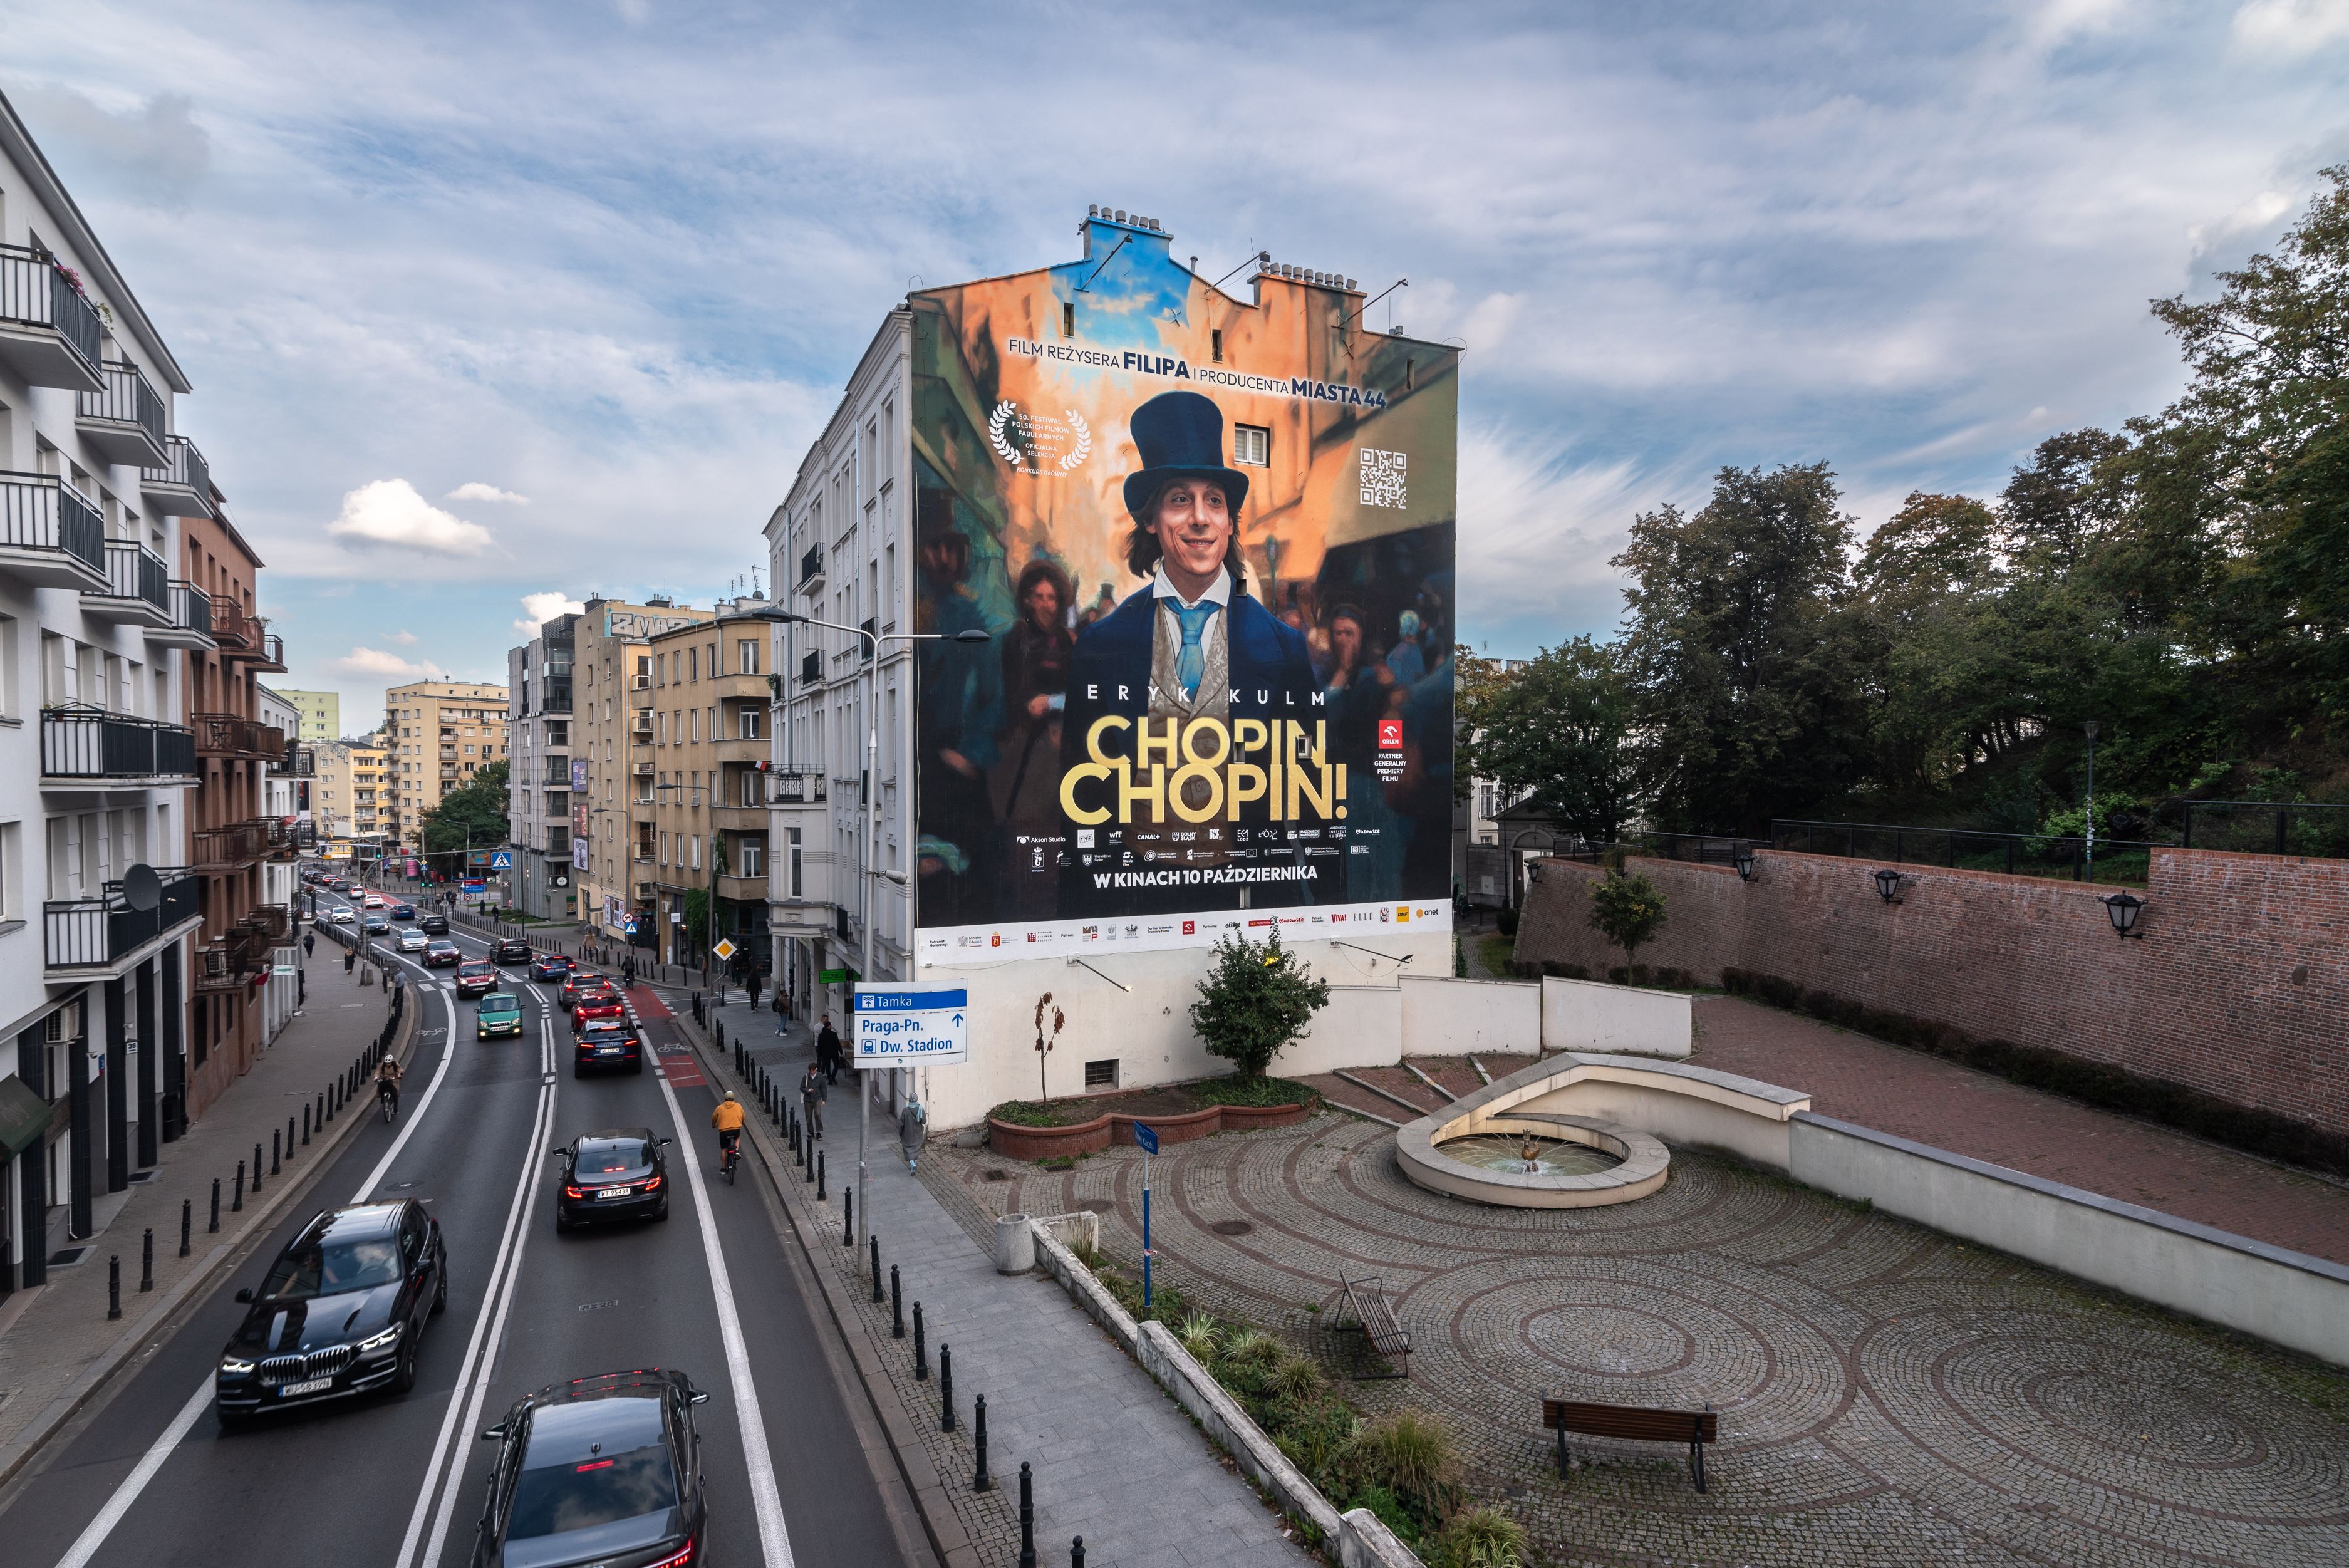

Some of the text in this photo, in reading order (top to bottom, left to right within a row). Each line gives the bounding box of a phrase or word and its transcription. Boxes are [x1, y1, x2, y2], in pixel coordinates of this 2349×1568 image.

[1009, 339, 1386, 408] FILM REŻYSERA FILIPA I PRODUCENTA MIASTA 44
[1030, 415, 1062, 425] FESTIWAL
[1012, 421, 1070, 434] POLSKICH FILMÓW
[1018, 430, 1064, 442] FABULARNYCH
[1025, 442, 1057, 452] OFICJALNA
[1027, 450, 1055, 459] SELEKCJA
[1016, 467, 1068, 477] KONKURS GŁÓWNY
[1087, 684, 1325, 705] ERYK KULM
[1086, 714, 1326, 769] CHOPIN
[1059, 762, 1347, 826] CHOPIN!
[1080, 835, 1092, 843] TVP
[1093, 864, 1318, 888] W KINACH 10 PAŹDZIERNIKA
[1331, 913, 1347, 923] VIVA!
[1354, 912, 1372, 922] ELLE
[878, 995, 912, 1007] Tamka
[863, 1019, 923, 1036] Praga-Pn.
[880, 1037, 952, 1053] Dw. Stadion
